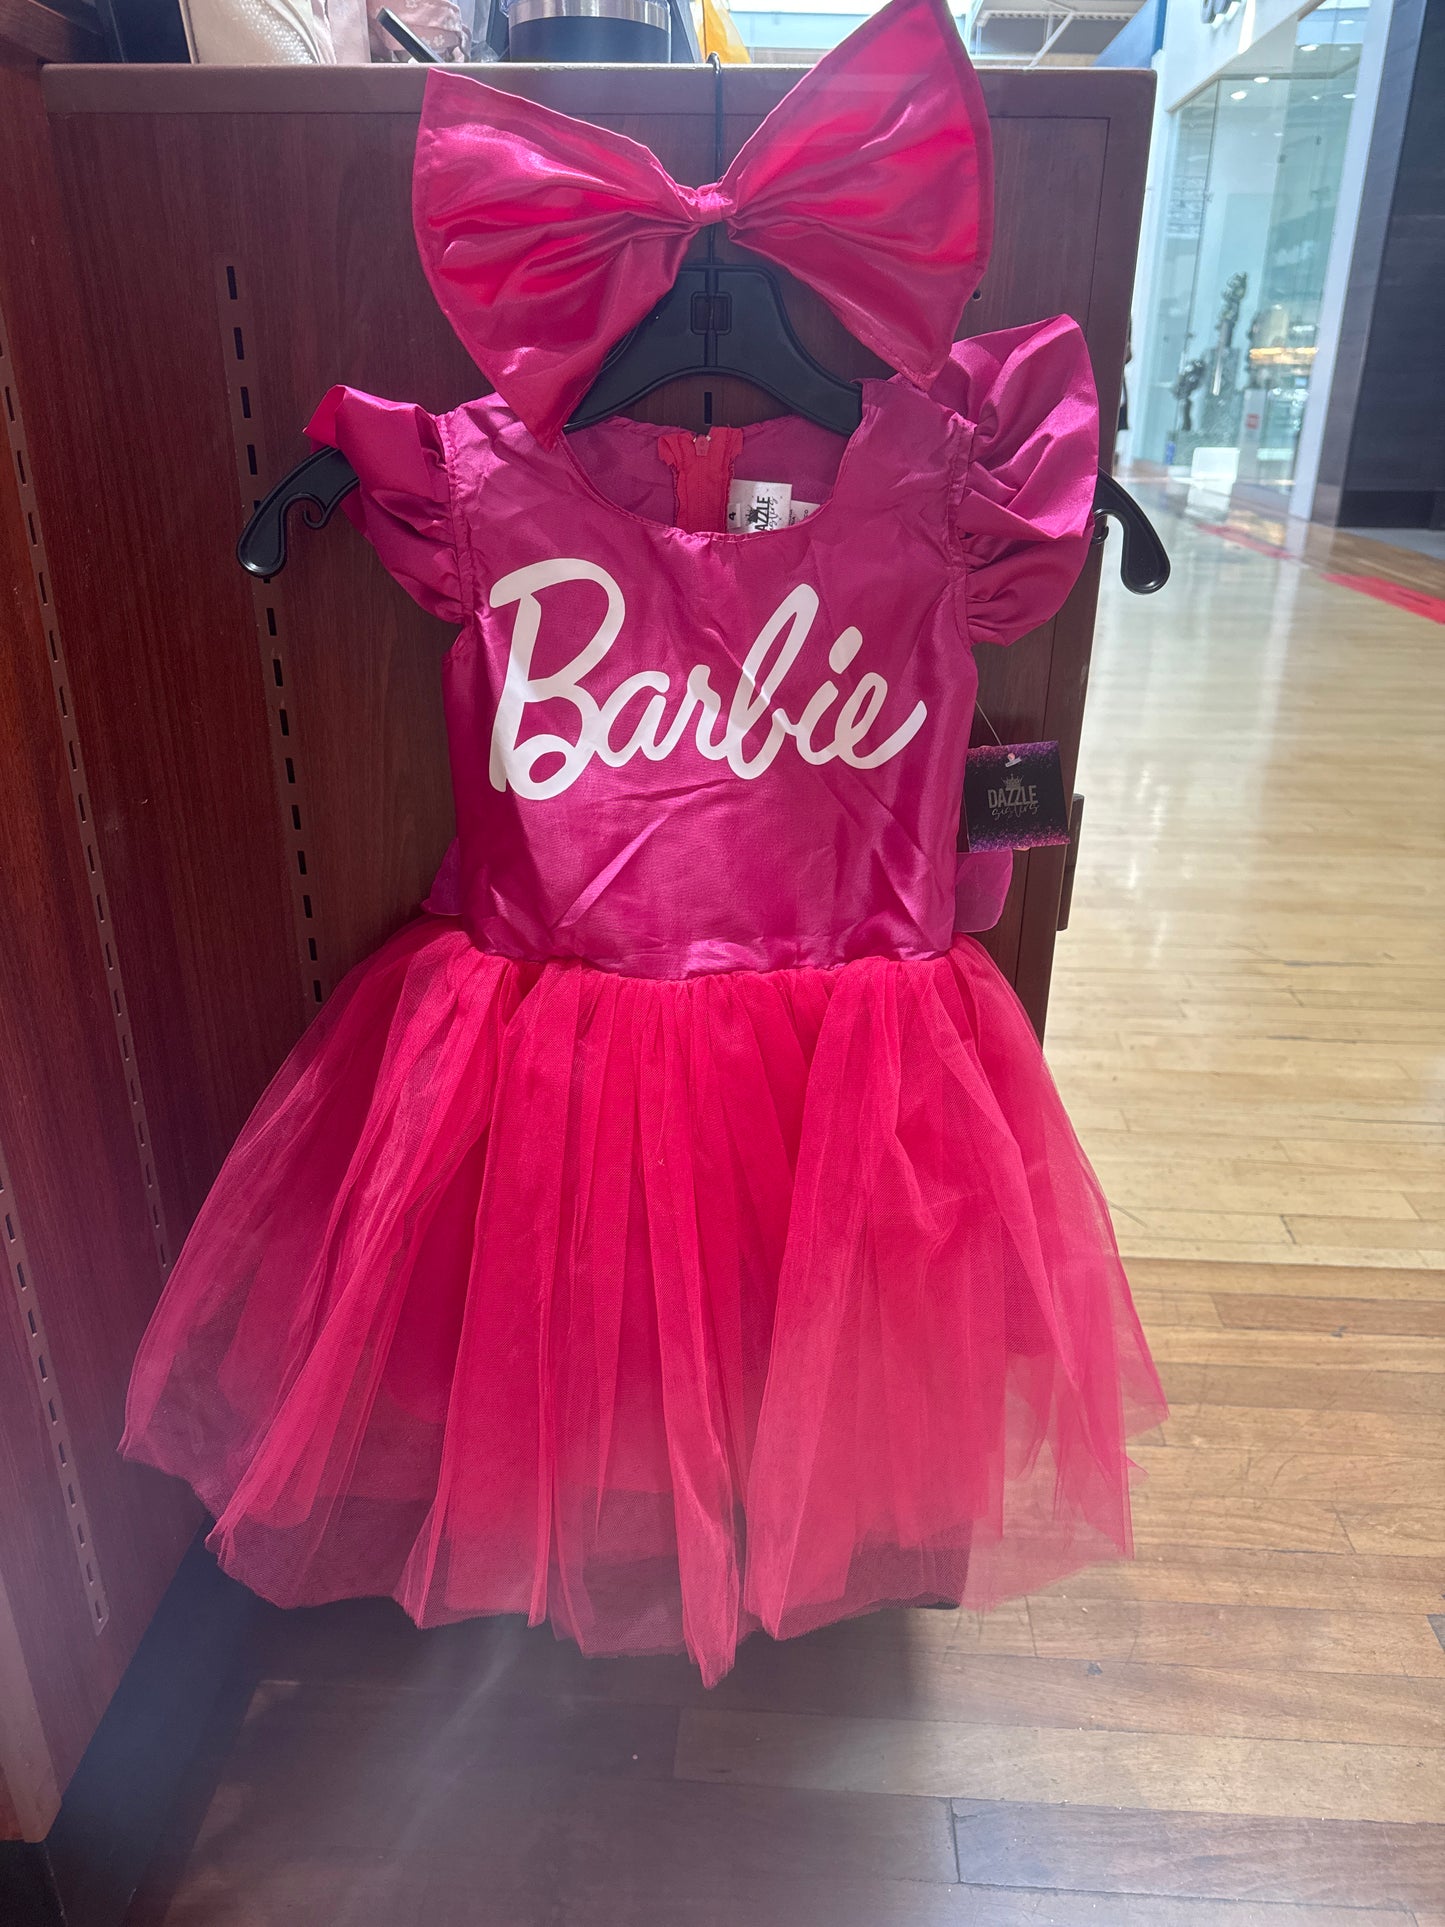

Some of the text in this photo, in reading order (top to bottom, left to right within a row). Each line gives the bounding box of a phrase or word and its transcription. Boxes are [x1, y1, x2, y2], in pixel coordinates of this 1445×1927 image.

[755, 495, 771, 532] AZZLE
[489, 558, 928, 800] Barbie
[987, 785, 1039, 809] DAZZLE
